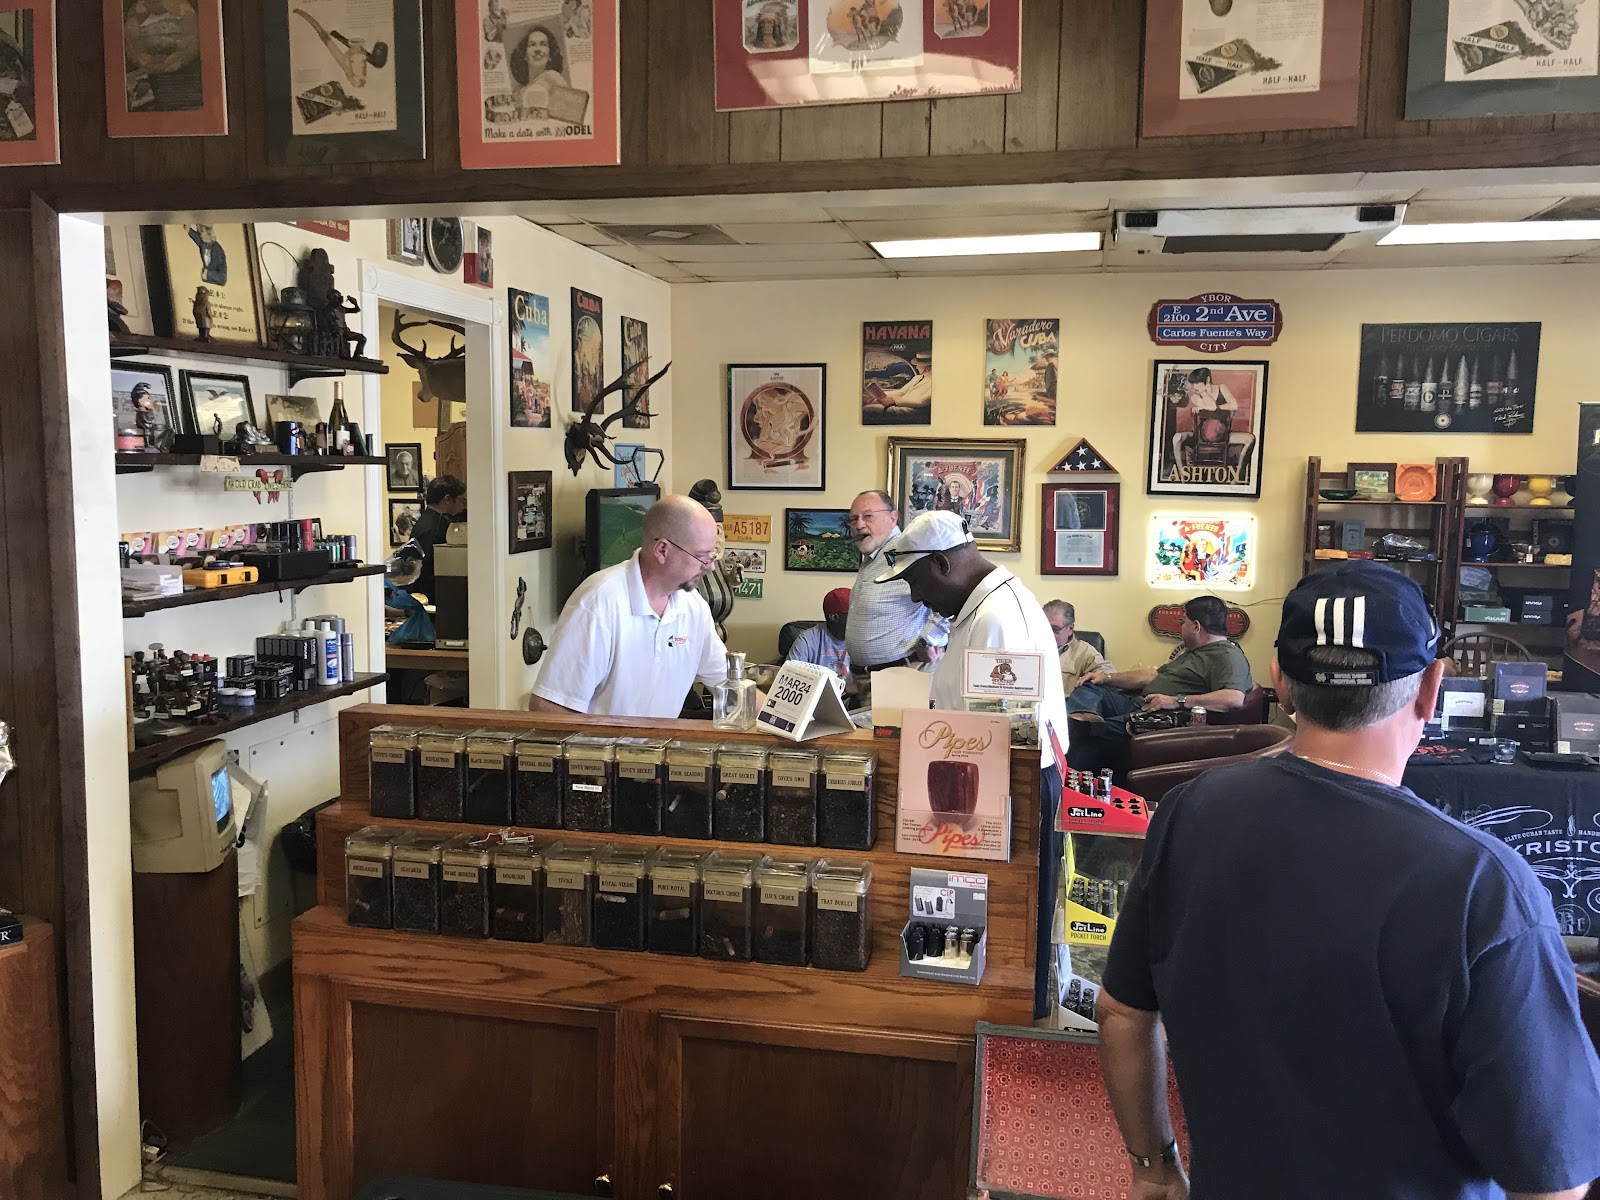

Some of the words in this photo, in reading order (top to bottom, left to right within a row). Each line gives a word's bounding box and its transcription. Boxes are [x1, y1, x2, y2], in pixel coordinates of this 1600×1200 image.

[1536, 59, 1555, 67] HALF
[1563, 58, 1583, 66] HALF
[1263, 76, 1282, 84] HALF
[1288, 74, 1307, 82] HALF
[484, 128, 507, 138] Make
[516, 128, 533, 137] date
[536, 127, 552, 136] with
[1201, 293, 1232, 304] YBOR
[514, 294, 548, 326] Cuba
[1173, 305, 1182, 314] E
[1195, 305, 1224, 322] 2nd
[1224, 305, 1268, 322] Ave
[1163, 313, 1190, 322] 2100
[865, 325, 931, 340] HAVANA
[993, 319, 1055, 348] Varadero
[1162, 328, 1197, 338] Carlos
[1199, 328, 1242, 338] Fuente's
[1244, 328, 1268, 339] Way
[1380, 326, 1460, 343] PERDOMO
[1462, 324, 1520, 342] CIGARS
[1020, 331, 1057, 349] CUBA
[1200, 341, 1229, 352] CITY
[1167, 464, 1242, 484] ASHTON
[235, 480, 247, 489] OLD
[247, 480, 262, 490] CRAB
[733, 521, 769, 535] A5187
[774, 685, 803, 706] 2000
[919, 720, 993, 760] Pipes
[1069, 807, 1103, 818] JetLine
[919, 821, 985, 853] Pipes
[1503, 833, 1521, 843] ELITE
[1522, 830, 1542, 838] CUBAN
[1543, 828, 1564, 836] TASTE
[948, 874, 986, 885] imco
[1072, 921, 1106, 933] JetLine
[1070, 932, 1089, 940] POCKET
[1090, 933, 1107, 941] TORCH
